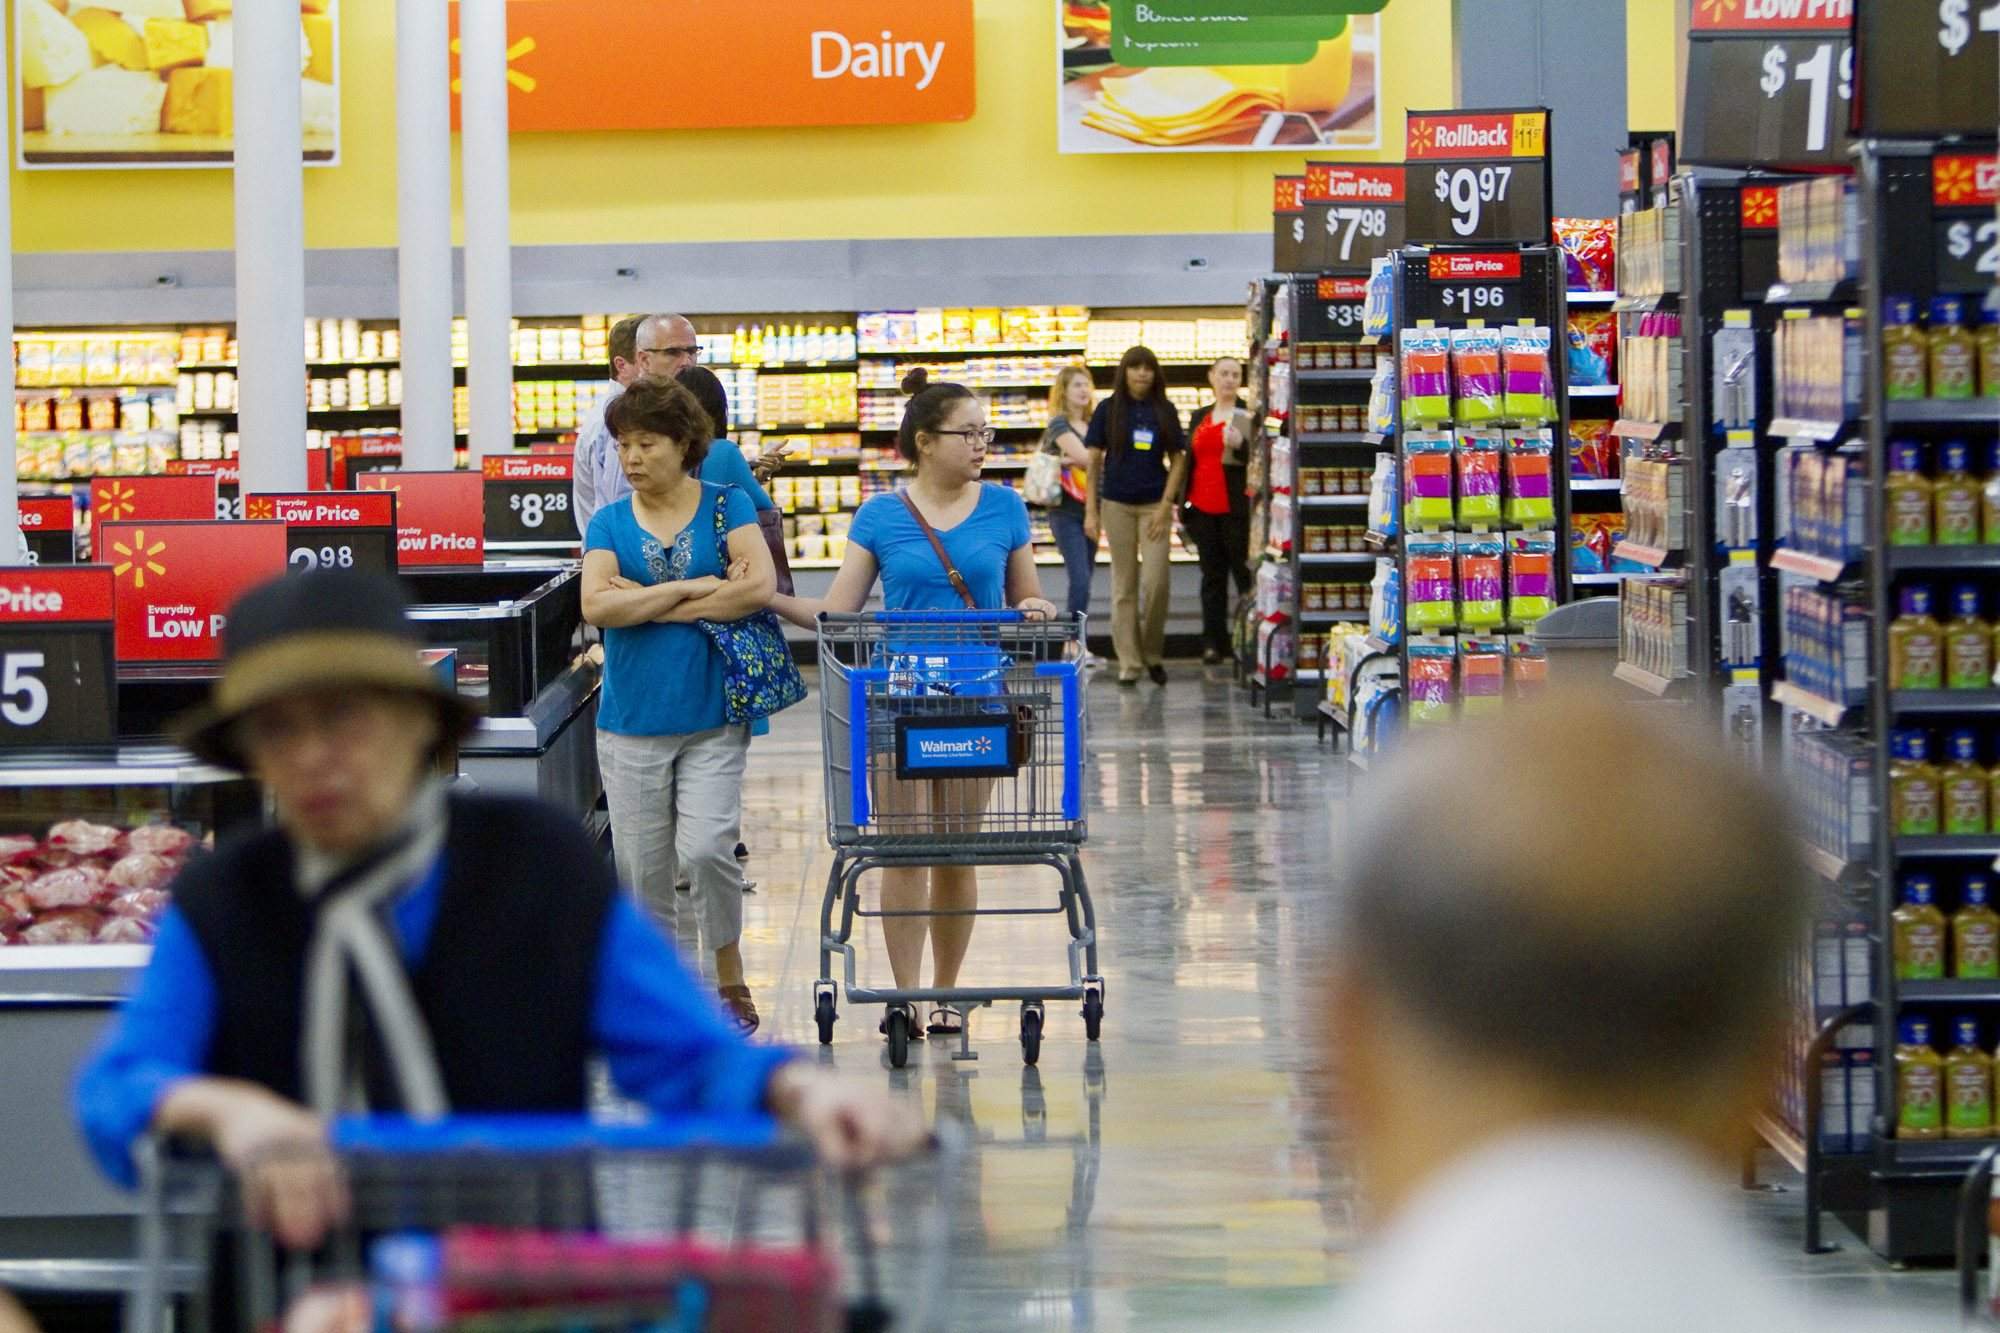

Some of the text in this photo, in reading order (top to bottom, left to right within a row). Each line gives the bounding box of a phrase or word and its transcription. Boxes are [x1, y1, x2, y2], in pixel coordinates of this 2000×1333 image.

[811, 30, 945, 91] Dairy
[1434, 123, 1508, 148] Rollback
[1329, 177, 1392, 197] Low Price
[1450, 260, 1504, 272] Low Price
[503, 463, 567, 477] Low Price
[275, 504, 360, 521] Low Price
[430, 532, 476, 551] Price
[148, 604, 196, 621] Everyday
[147, 615, 204, 638] Low
[919, 739, 974, 754] Walmart
